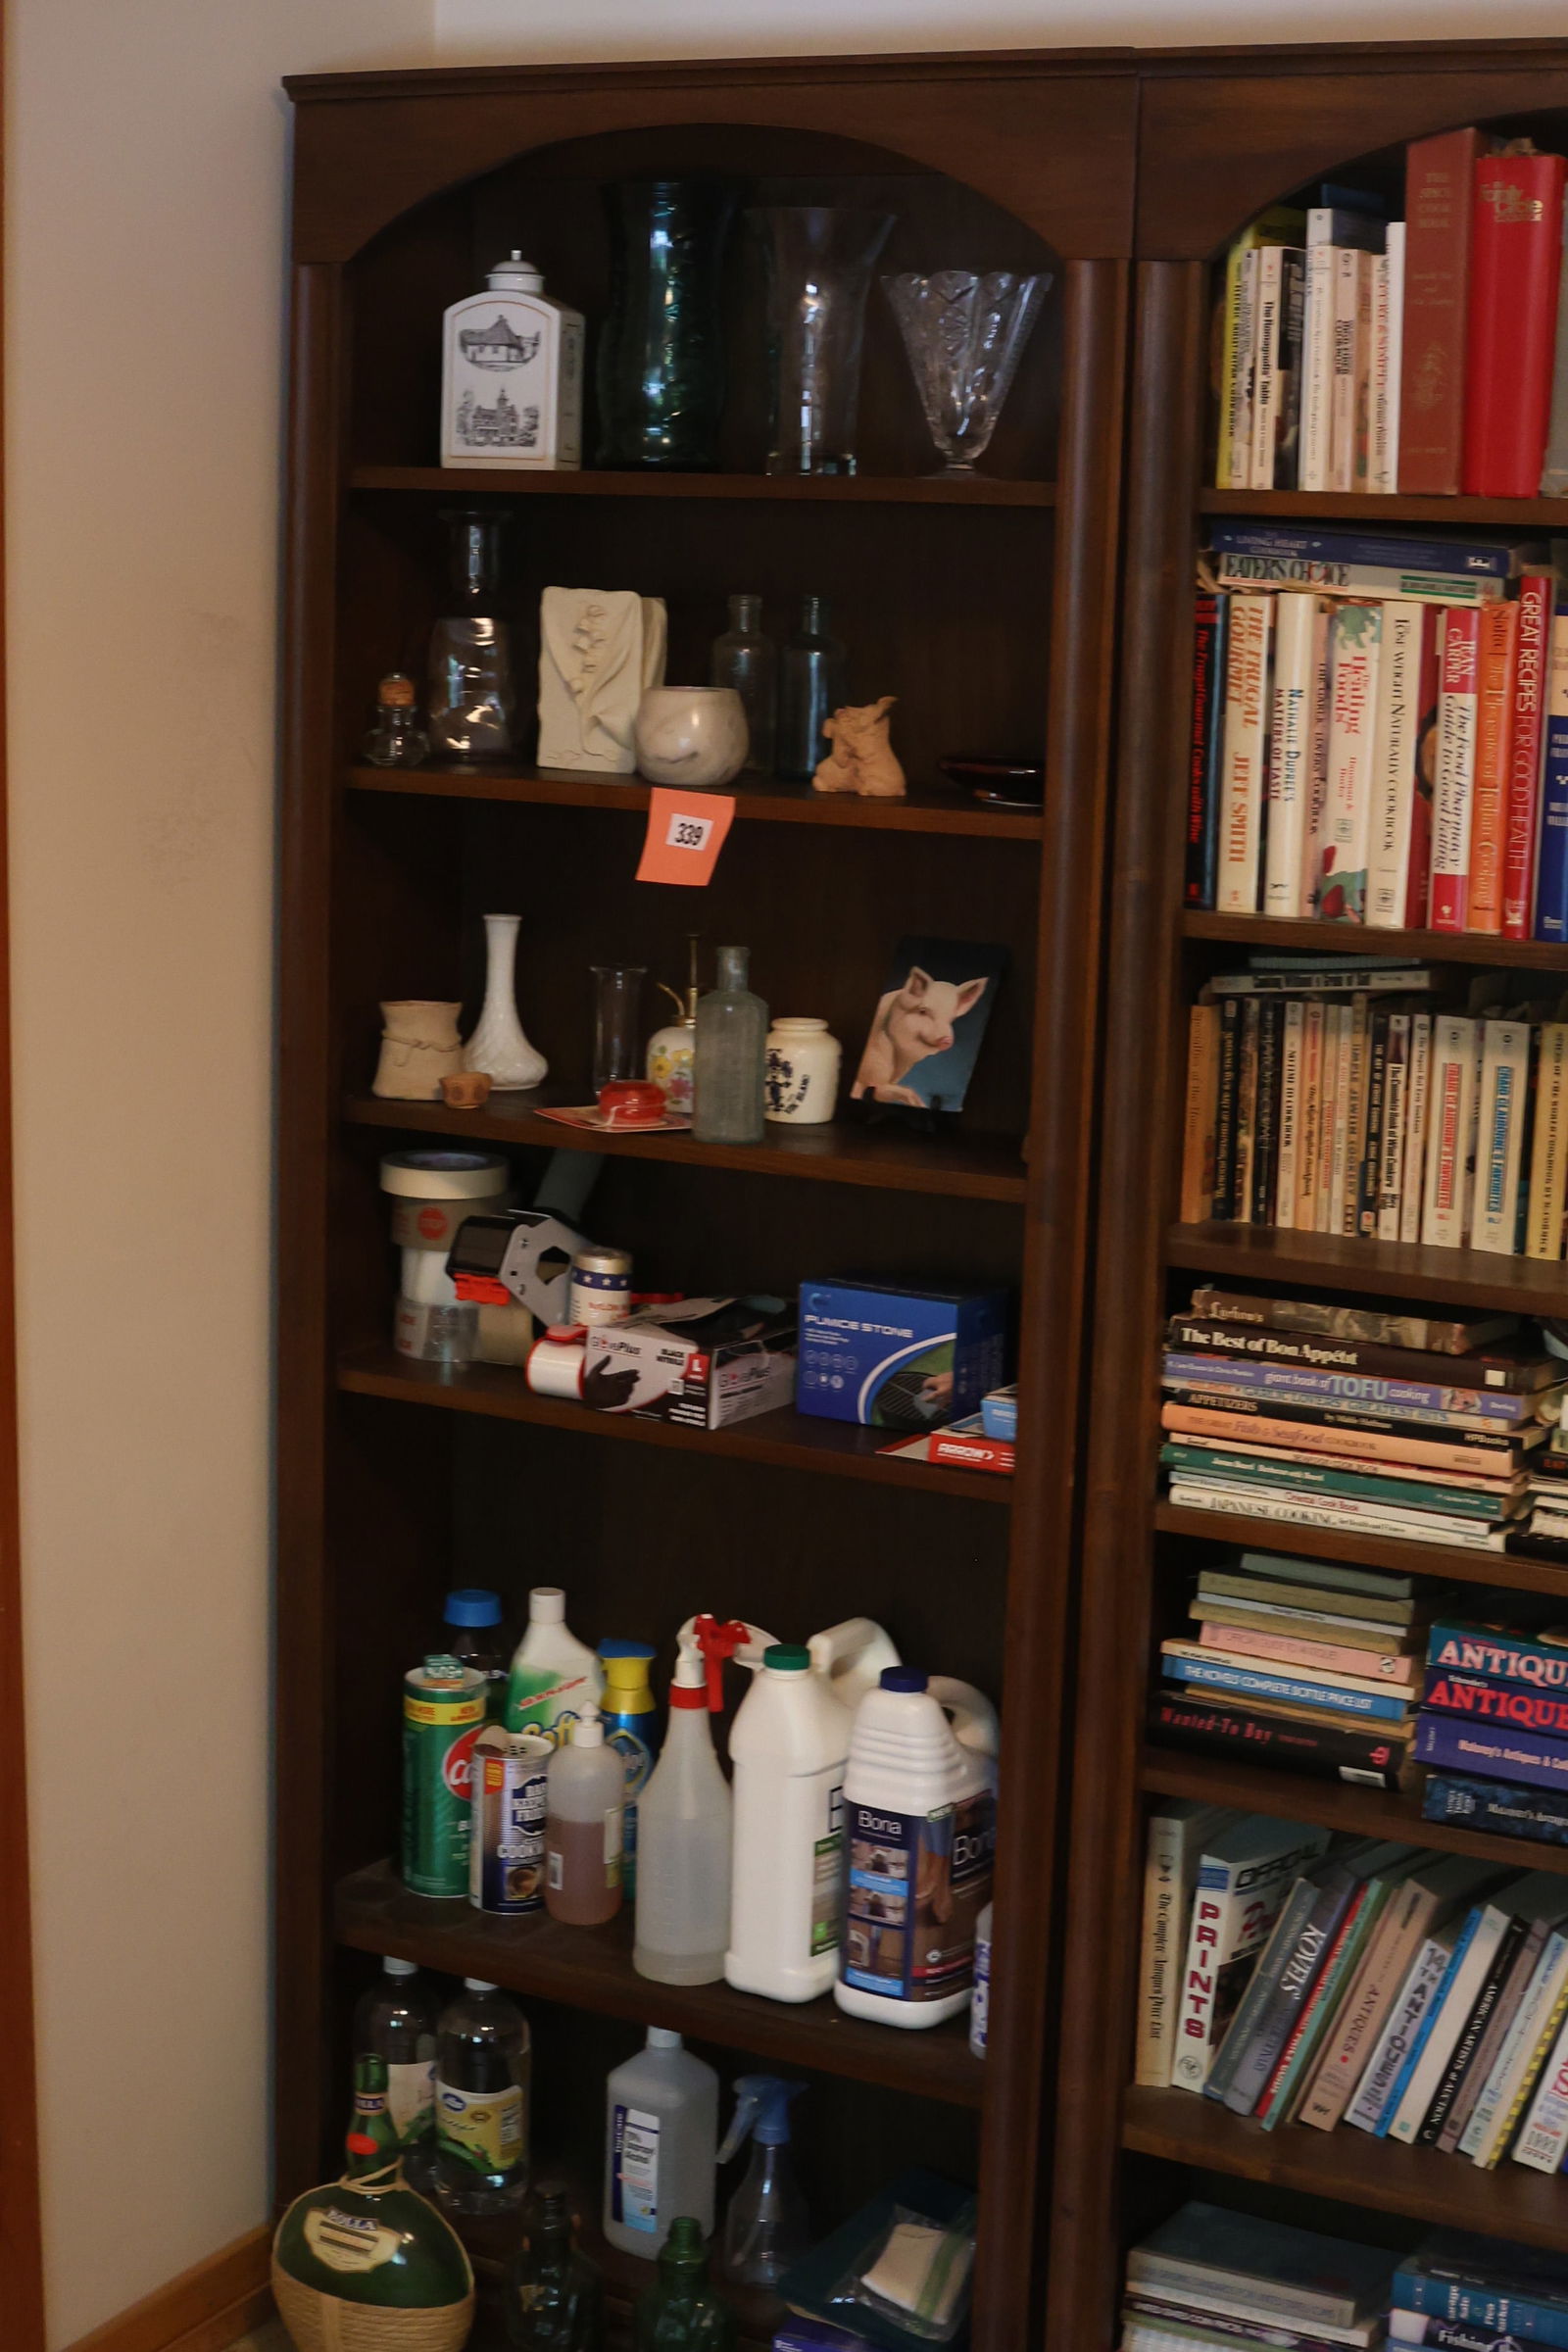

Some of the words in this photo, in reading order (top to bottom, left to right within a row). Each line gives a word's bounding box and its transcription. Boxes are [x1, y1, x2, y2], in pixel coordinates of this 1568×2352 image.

[1264, 301, 1274, 318] The
[1259, 380, 1270, 406] Table
[1248, 607, 1264, 644] THE
[1520, 591, 1544, 647] GREAT
[1193, 651, 1208, 691] Frugal
[1227, 606, 1246, 708] GOURMET
[1446, 627, 1463, 684] CARPER
[1459, 639, 1476, 676] JEAN
[1243, 649, 1262, 729] FRUGAL
[1335, 662, 1352, 724] Foods
[1344, 656, 1366, 735] Healing
[1515, 648, 1541, 712] RECIPES
[1272, 688, 1285, 744] MATTERS
[1286, 688, 1304, 744] NATHALIE
[1443, 695, 1458, 746] Guide
[1457, 704, 1472, 733] The
[1512, 714, 1537, 748] FOR
[1272, 746, 1284, 760] OF
[1388, 703, 1405, 778] NATURALLY
[1441, 747, 1454, 760] to
[1453, 734, 1471, 778] Food
[1233, 752, 1251, 799] JEFF
[1270, 765, 1283, 801] TASTE
[1284, 750, 1302, 802] DUPREE'S
[1439, 767, 1454, 814] Good
[1510, 750, 1532, 802] GOOD
[1228, 802, 1249, 863] SMITH
[1383, 779, 1399, 853] COOKBOOK
[1449, 780, 1468, 867] Pharmacy
[1477, 785, 1500, 836] Italian
[674, 821, 705, 847] 339
[1434, 816, 1451, 870] Eating
[1506, 804, 1531, 871] HEALTH
[1373, 1057, 1384, 1070] ART
[1392, 1066, 1403, 1078] The
[1446, 1062, 1461, 1094] CRAIG
[1495, 1065, 1511, 1096] CRAIG
[1552, 1064, 1561, 1077] OF
[1551, 1080, 1561, 1099] THE
[1442, 1094, 1458, 1157] CLAIBORNE'S
[1492, 1097, 1509, 1160] CLAIBORNE'S
[1437, 1158, 1454, 1209] FAVORITES
[1488, 1161, 1505, 1213] FAVORITES
[804, 1314, 860, 1332] PUMICE
[860, 1322, 914, 1339] STONE
[1180, 1327, 1211, 1345] The
[1211, 1331, 1247, 1351] Best
[1246, 1337, 1266, 1351] of
[1265, 1339, 1299, 1357] Bon
[691, 1358, 703, 1373] L
[1264, 1371, 1292, 1387] giant
[1293, 1374, 1321, 1389] book
[1320, 1377, 1332, 1392] of
[1330, 1375, 1391, 1400] TOFU
[1388, 1387, 1432, 1405] cooking
[1188, 1393, 1258, 1412] APPETIZERS
[1314, 1495, 1338, 1509] Cook
[1337, 1500, 1360, 1513] Book
[857, 1809, 903, 1836] Bona
[1158, 1892, 1172, 1910] The
[1152, 1912, 1170, 1952] Complete
[1185, 1902, 1221, 2039] PRINTS
[1279, 1923, 1327, 2000] KOVELS'
[1344, 1984, 1381, 2054] ANTIQUES
[1471, 1982, 1498, 2031] AMERICAN
[1454, 2034, 1478, 2072] ARTISTS
[1431, 2082, 1456, 2126] AUCTION
